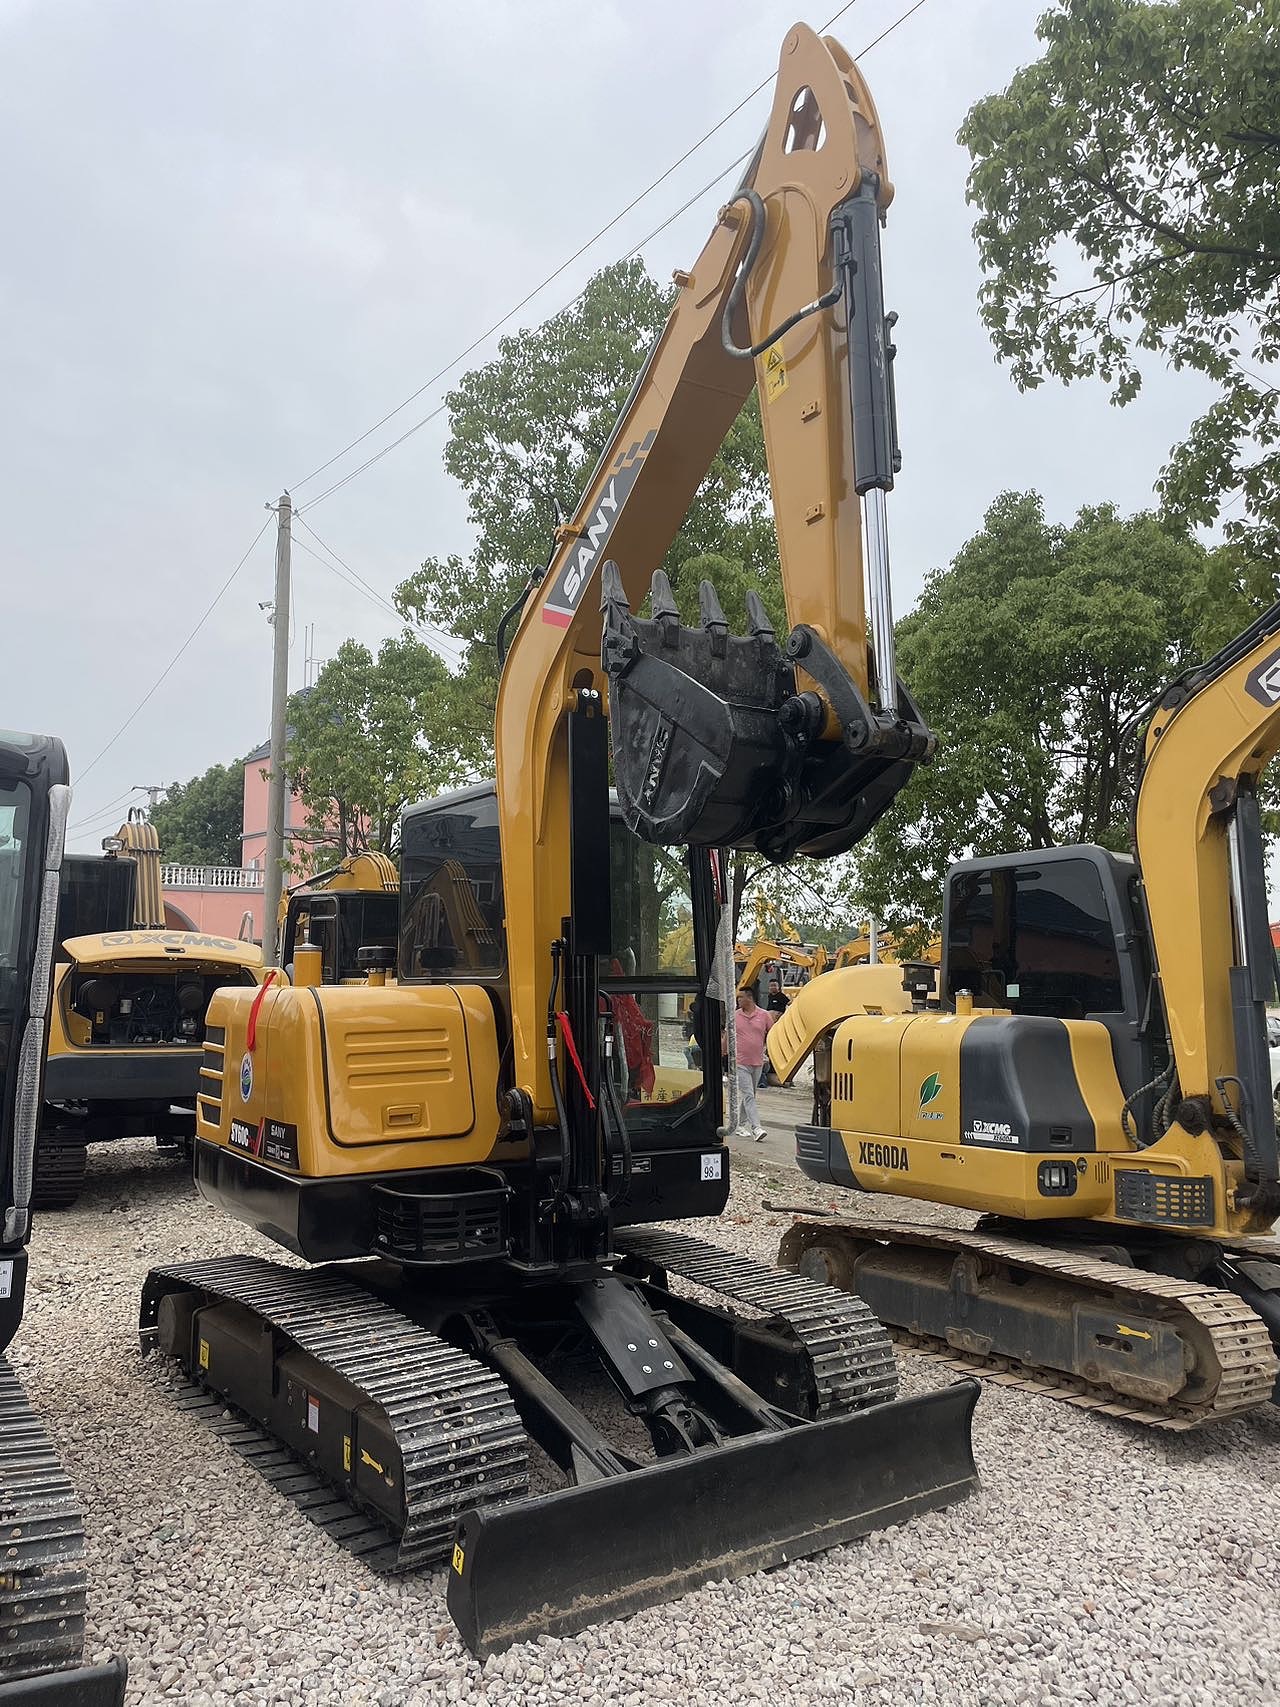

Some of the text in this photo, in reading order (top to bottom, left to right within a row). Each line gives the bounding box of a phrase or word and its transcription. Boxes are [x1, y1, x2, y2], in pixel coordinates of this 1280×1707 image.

[563, 478, 618, 604] SANY
[135, 933, 238, 950] XCMG
[270, 1124, 286, 1139] SANY
[982, 1121, 1012, 1136] XCMG
[858, 1141, 909, 1171] XE60DA
[704, 1165, 714, 1178] 98
